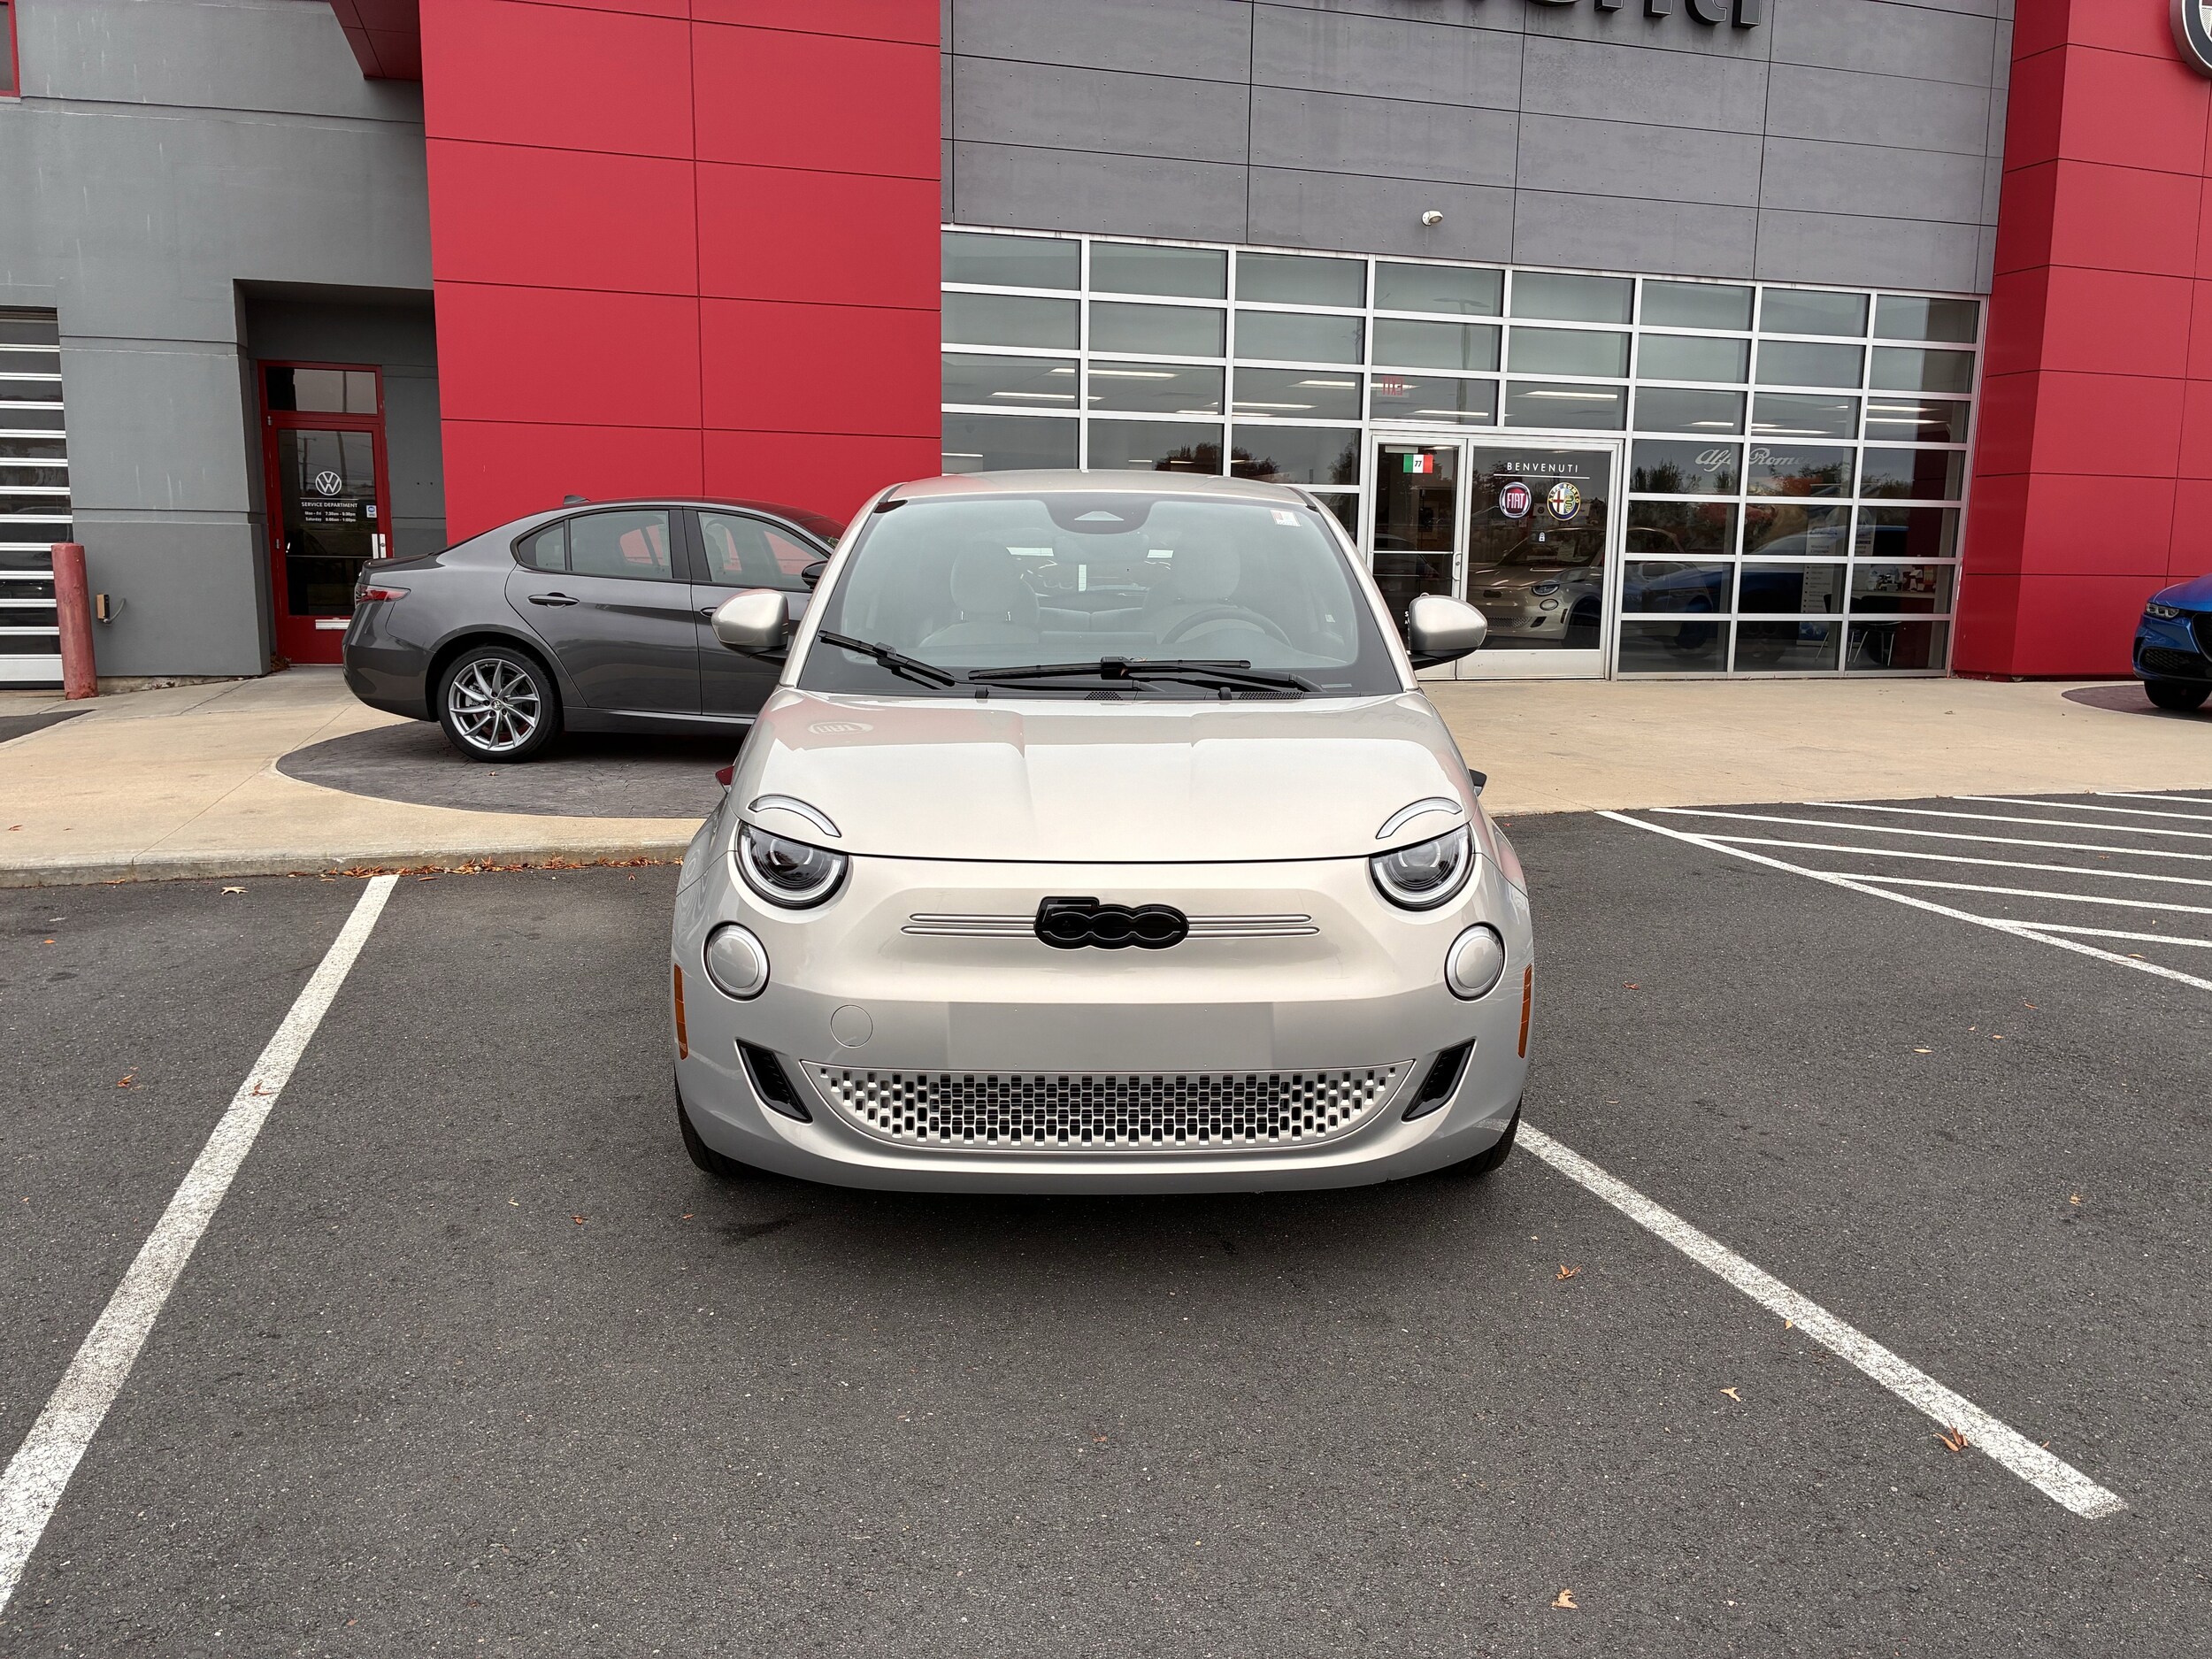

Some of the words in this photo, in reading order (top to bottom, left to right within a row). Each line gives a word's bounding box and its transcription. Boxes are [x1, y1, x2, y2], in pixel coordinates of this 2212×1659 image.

[1507, 462, 1578, 473] BENVENUTI
[1507, 493, 1525, 510] FIAT
[1033, 896, 1189, 949] 500
